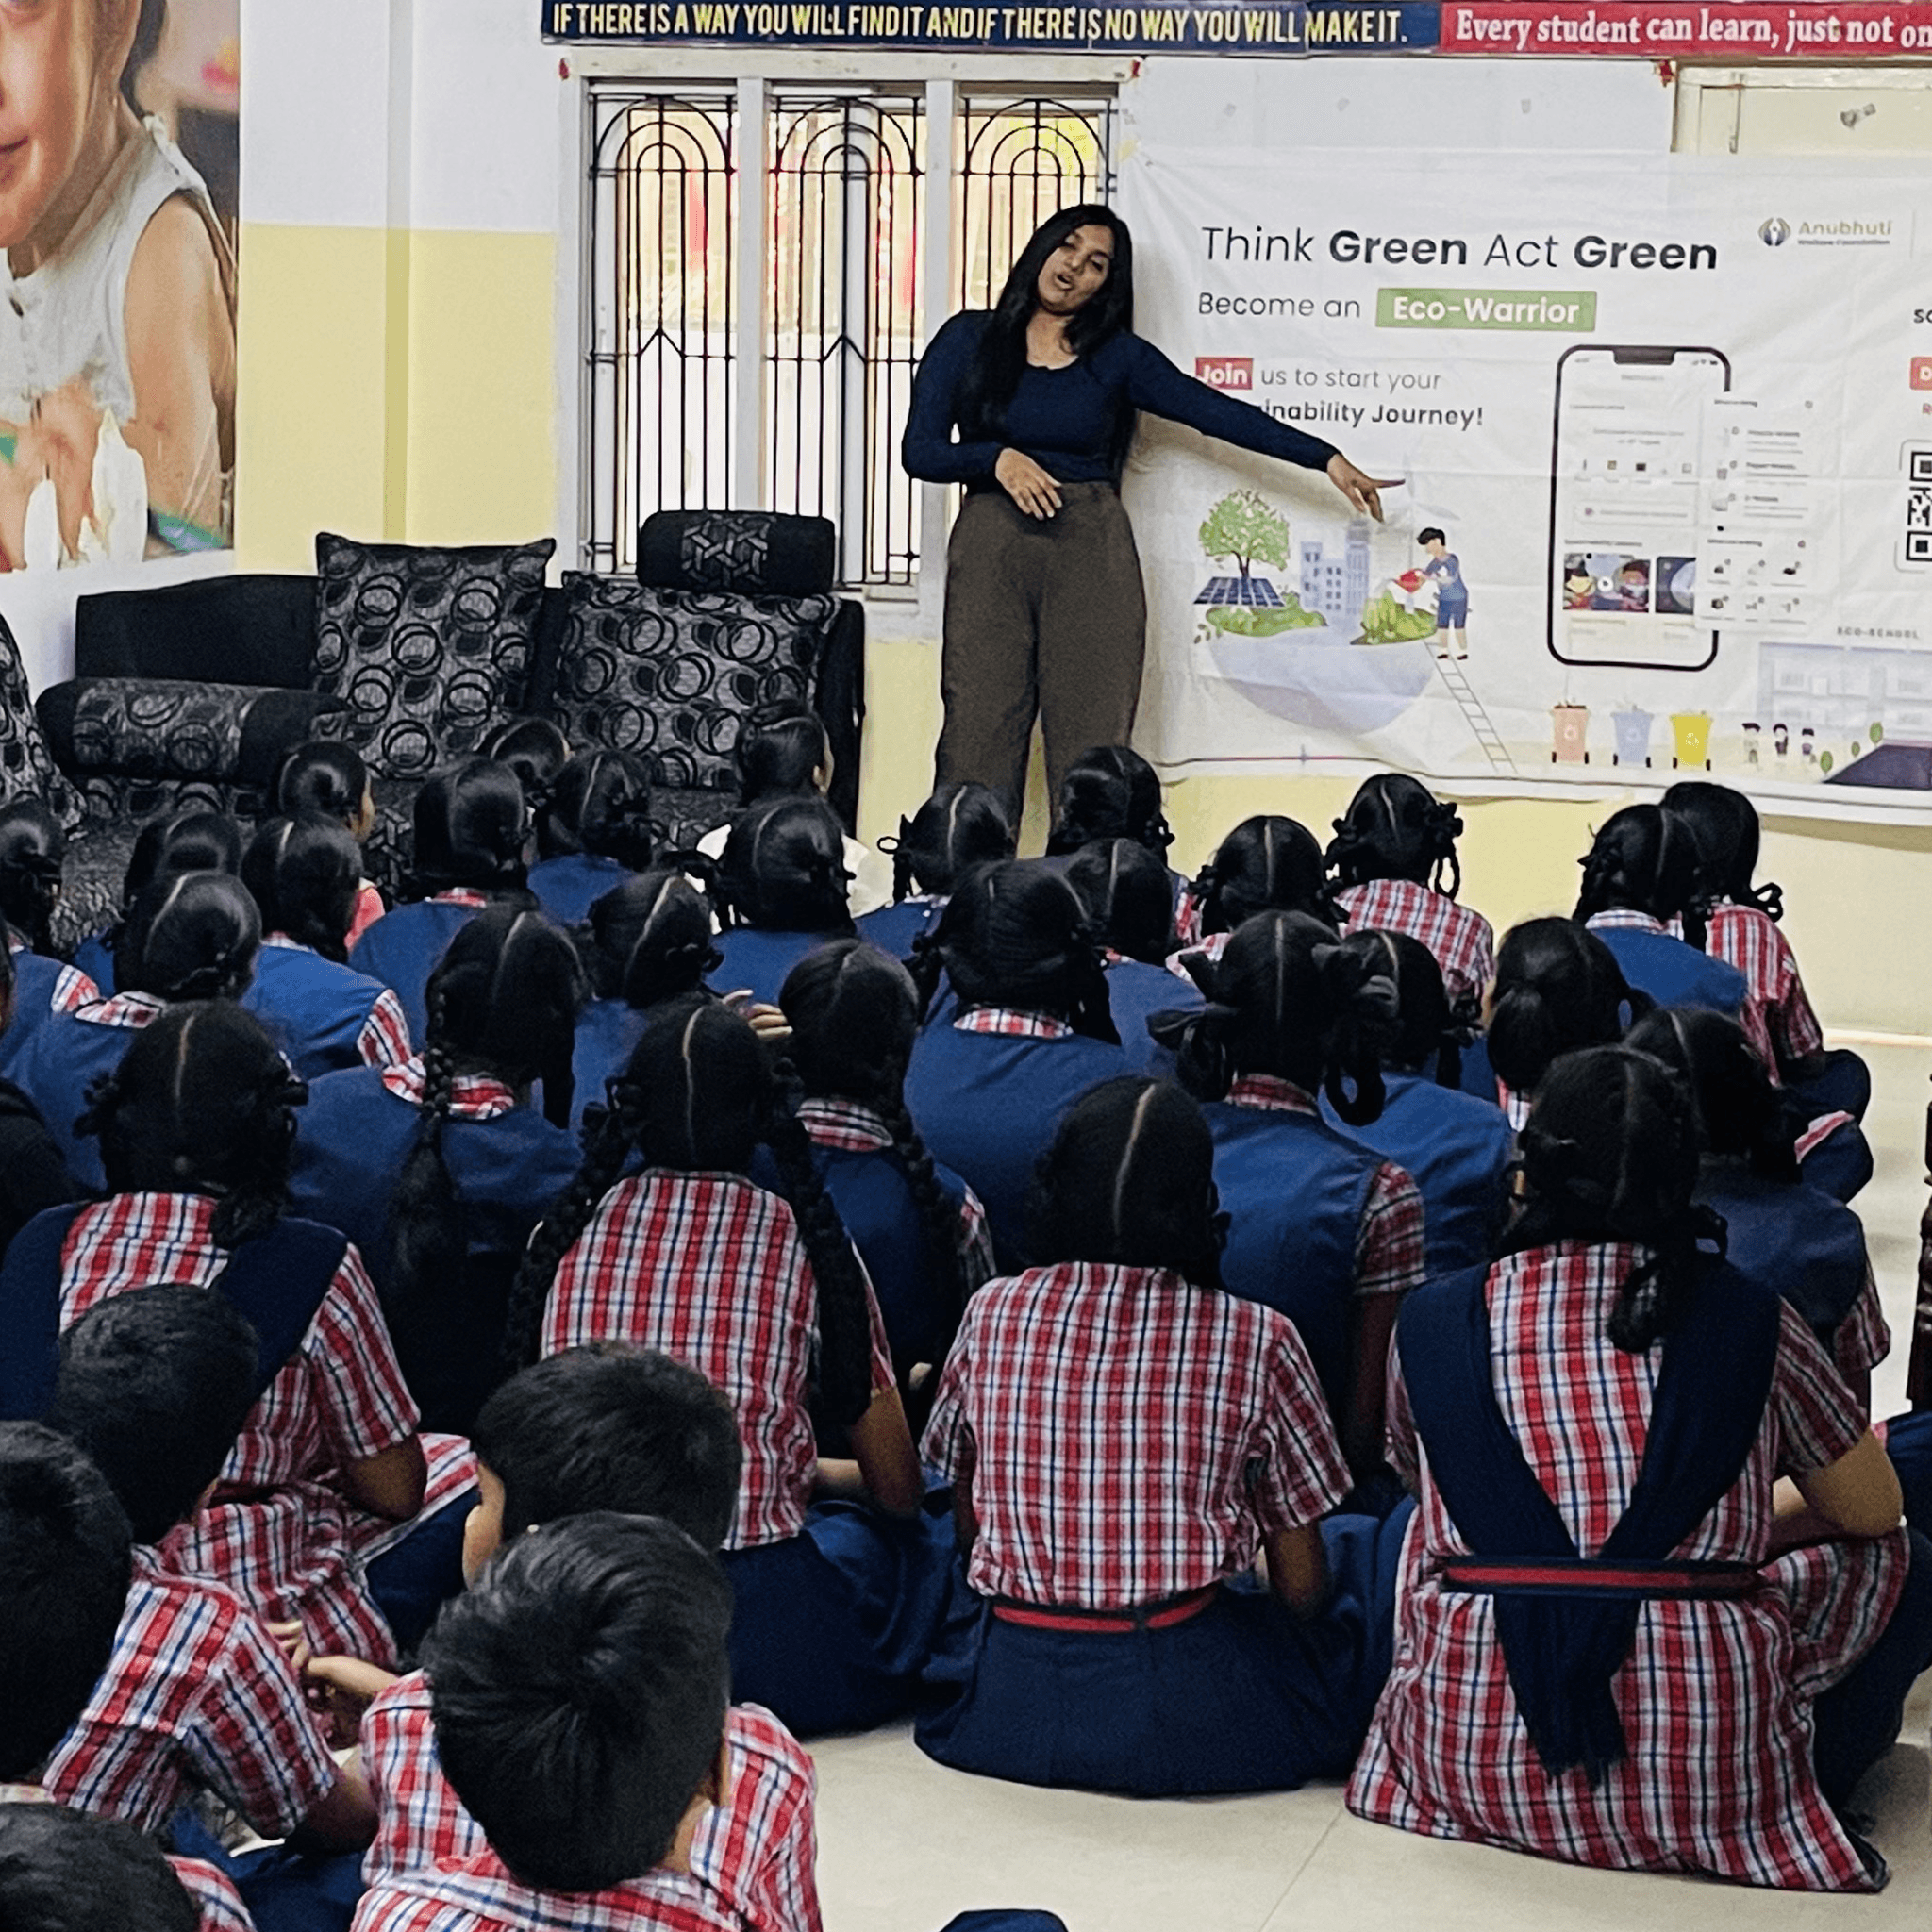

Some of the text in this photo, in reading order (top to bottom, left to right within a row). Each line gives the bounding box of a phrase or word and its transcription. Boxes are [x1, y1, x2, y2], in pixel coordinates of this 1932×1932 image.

[554, 4, 573, 33] IF
[576, 4, 646, 33] THERE
[650, 4, 670, 33] IS
[675, 4, 689, 33] A
[692, 4, 740, 34] WAY
[743, 5, 788, 34] YOU
[791, 5, 845, 35] WILL
[849, 6, 899, 36] FIND
[902, 6, 924, 36] IT
[926, 7, 974, 38] AND
[977, 8, 998, 39] IF
[1002, 6, 1076, 39] THERE
[1079, 8, 1102, 40] IS
[1104, 9, 1137, 40] NO
[1141, 9, 1190, 42] WAY
[1193, 10, 1240, 42] YOU
[1244, 10, 1300, 42] WILL
[1305, 10, 1375, 42] MAKE
[1457, 9, 1532, 50] Every
[1537, 10, 1641, 43] student
[1646, 18, 1692, 41] can
[1699, 8, 1779, 48] learn,
[1785, 9, 1840, 52] just
[1845, 16, 1894, 42] not
[1799, 221, 1892, 235] Anubhuti
[1202, 225, 1717, 270] Think Green Act Green
[1199, 292, 1580, 324] Become an Eco-Warrior
[1201, 362, 1441, 394] Join us to start your
[1260, 399, 1483, 432] inability Journey!
